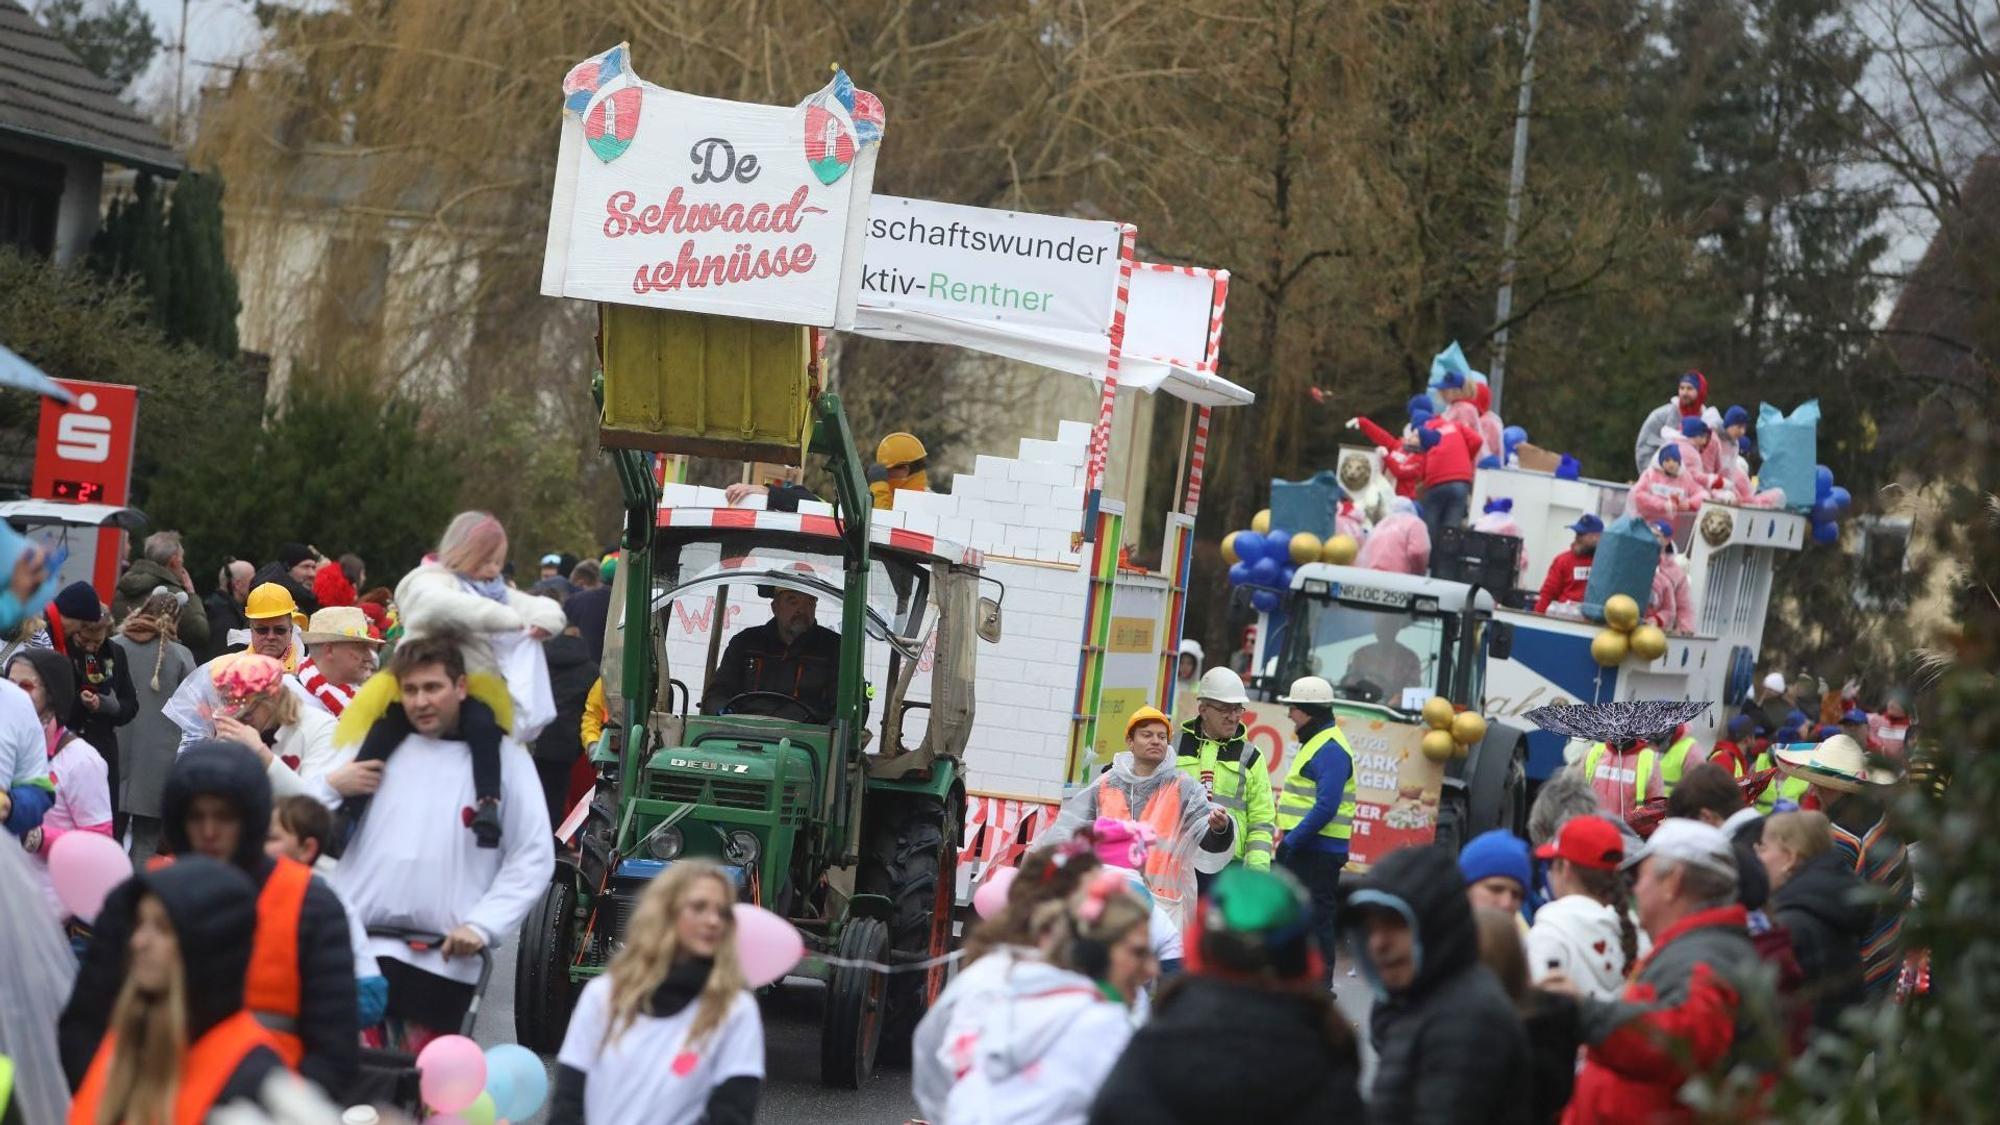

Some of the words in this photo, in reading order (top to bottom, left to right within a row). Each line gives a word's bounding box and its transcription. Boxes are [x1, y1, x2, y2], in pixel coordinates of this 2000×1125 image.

[689, 137, 761, 184] De
[603, 184, 828, 238] Schwaad-
[632, 239, 817, 294] schnüsse
[1341, 584, 1355, 598] NR
[1363, 588, 1380, 601] OC
[674, 595, 741, 634] Wr
[671, 758, 749, 774] DEUTZ
